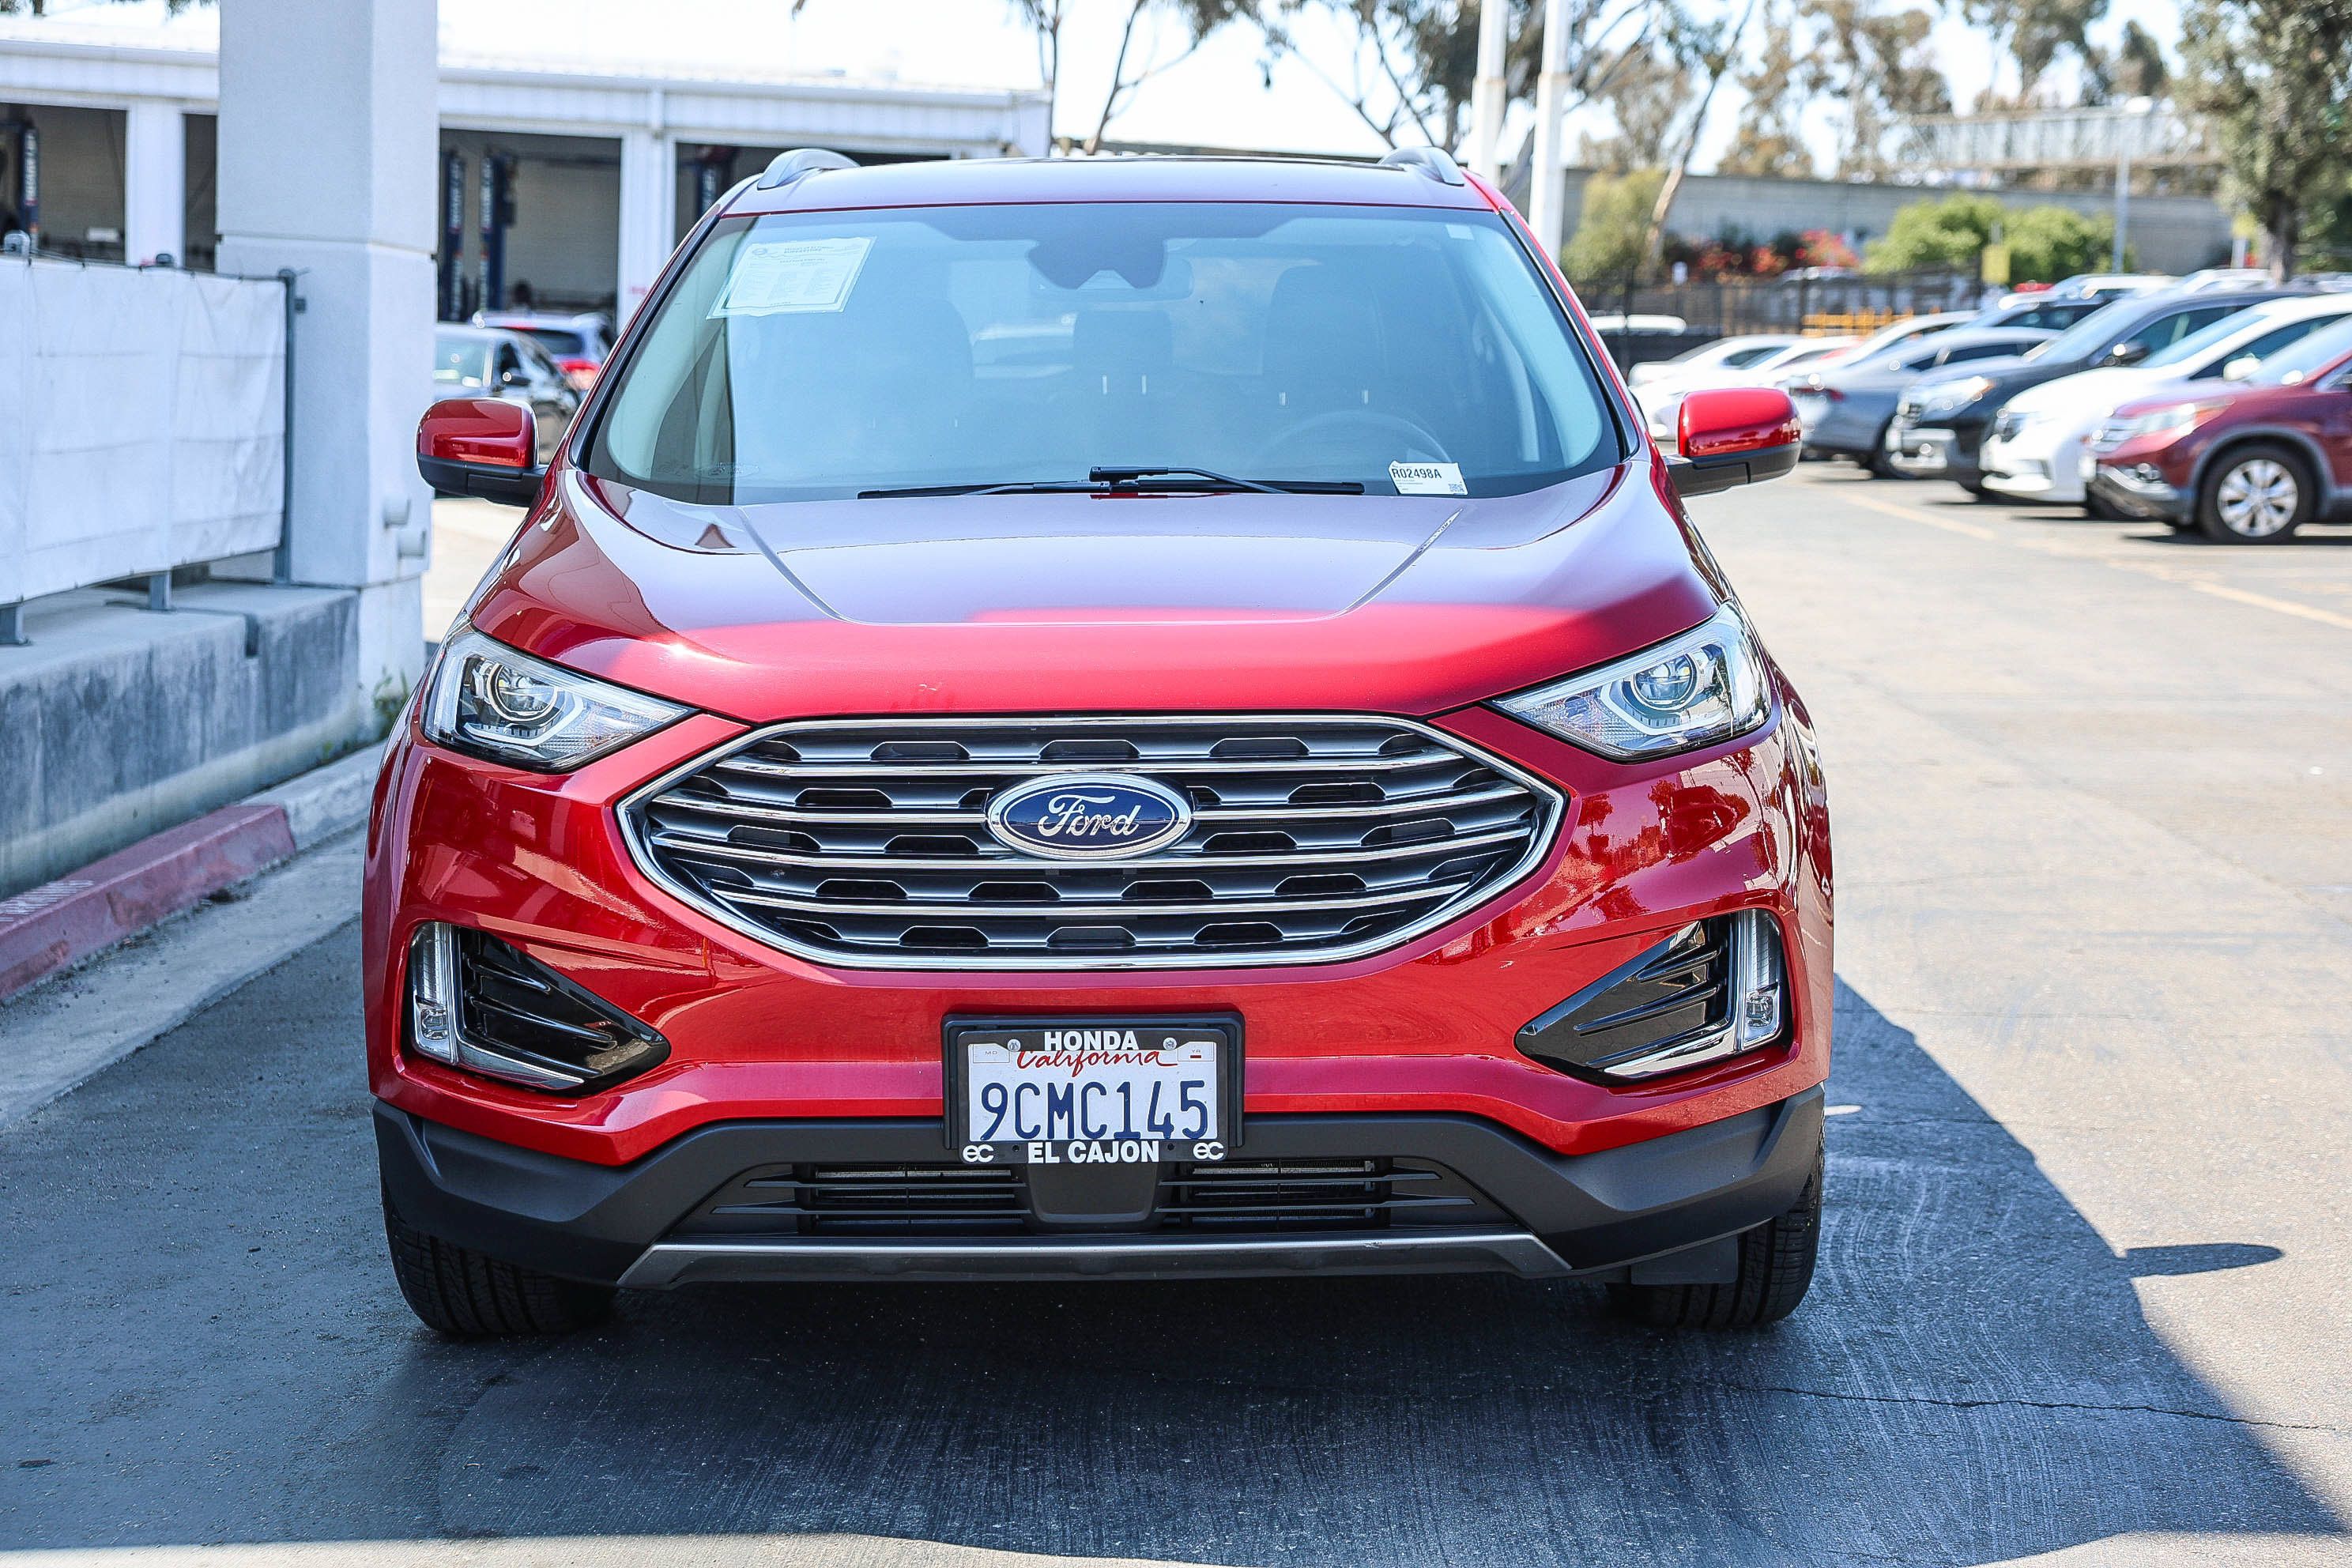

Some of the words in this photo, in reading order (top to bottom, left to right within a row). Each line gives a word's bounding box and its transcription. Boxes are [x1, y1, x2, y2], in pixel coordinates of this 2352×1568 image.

[1391, 468, 1442, 479] R02498A
[1038, 793, 1142, 837] Ford
[1043, 1031, 1140, 1051] HONDA
[1017, 1050, 1178, 1078] California
[981, 1080, 1208, 1140] 9CMC145
[1027, 1141, 1061, 1164] EL
[1067, 1140, 1159, 1163] CAJON
